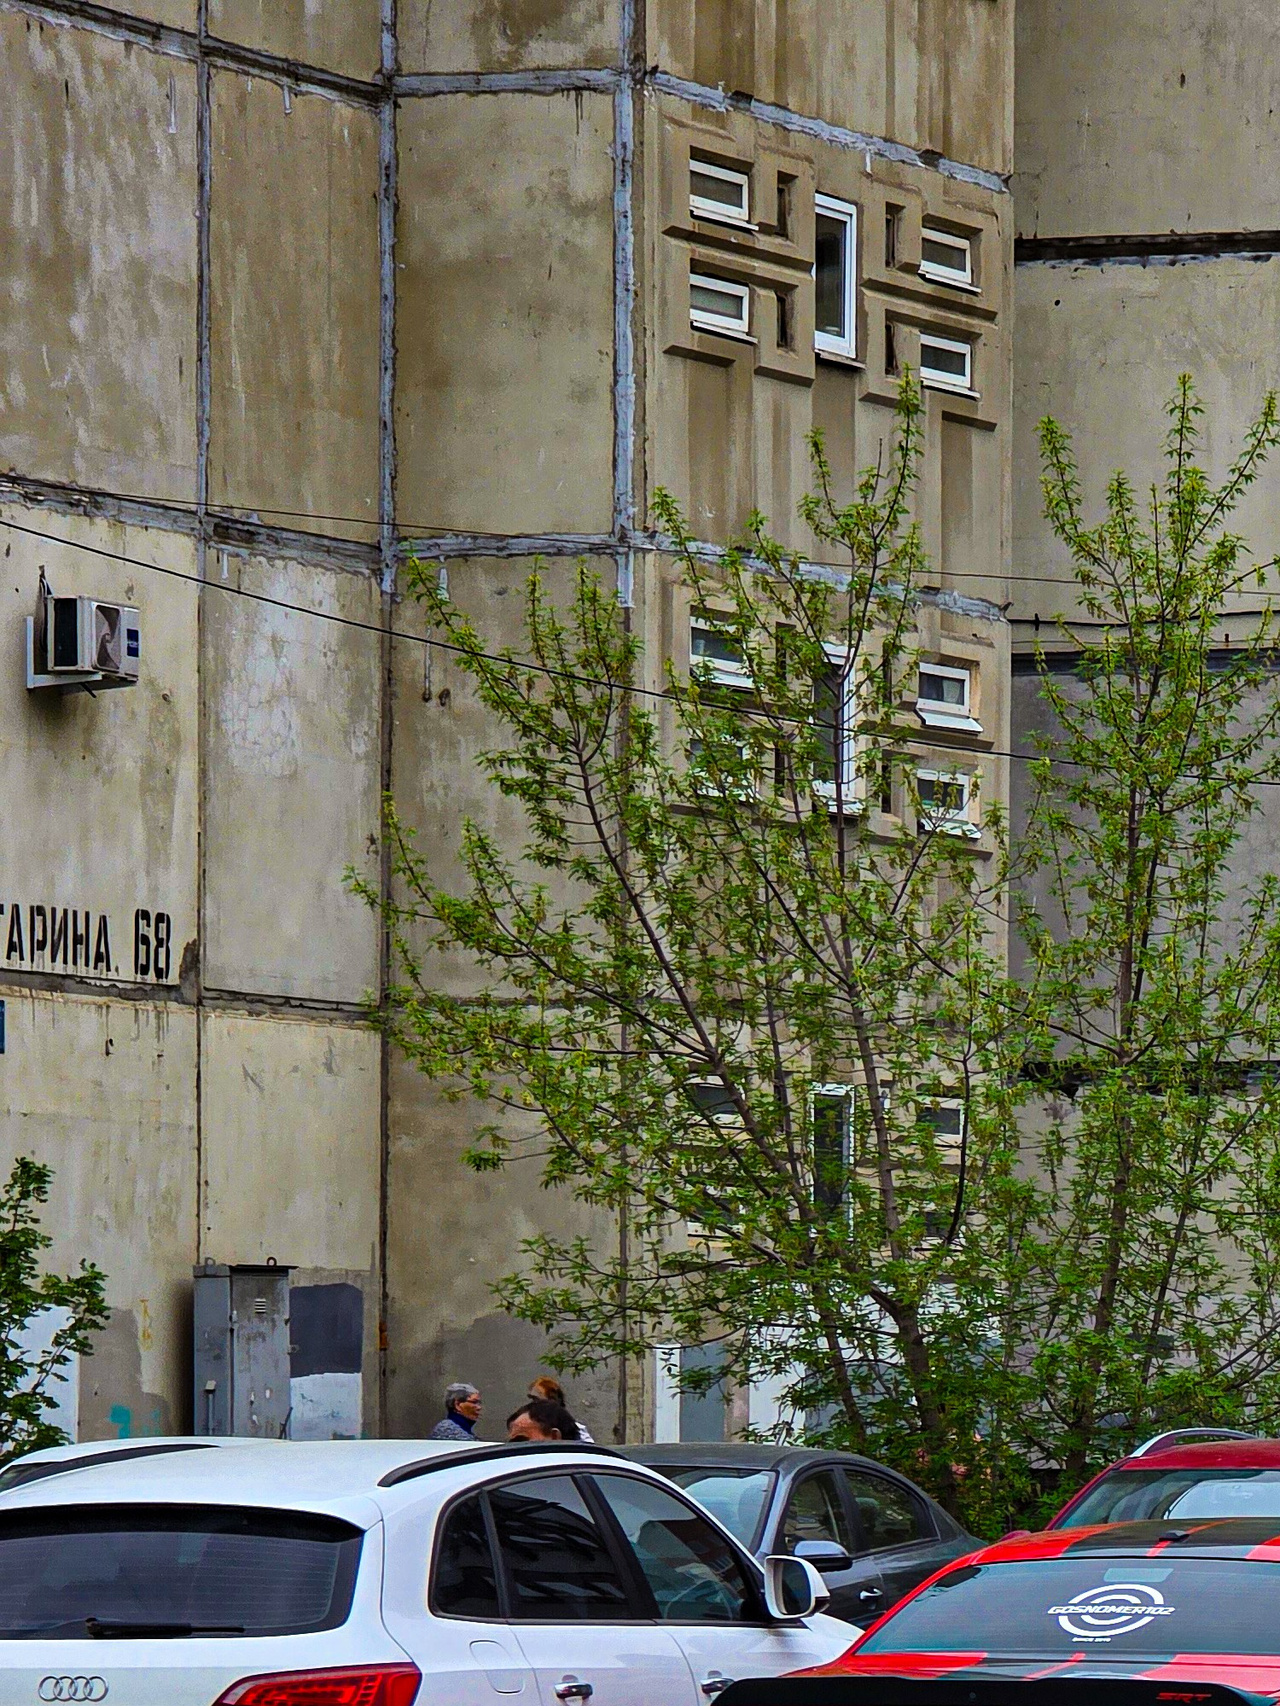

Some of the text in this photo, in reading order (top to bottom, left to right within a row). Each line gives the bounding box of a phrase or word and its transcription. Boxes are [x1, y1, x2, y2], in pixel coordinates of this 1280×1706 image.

[0, 903, 171, 980] АРИНА 68
[1047, 1605, 1176, 1615] GOSNOMER102
